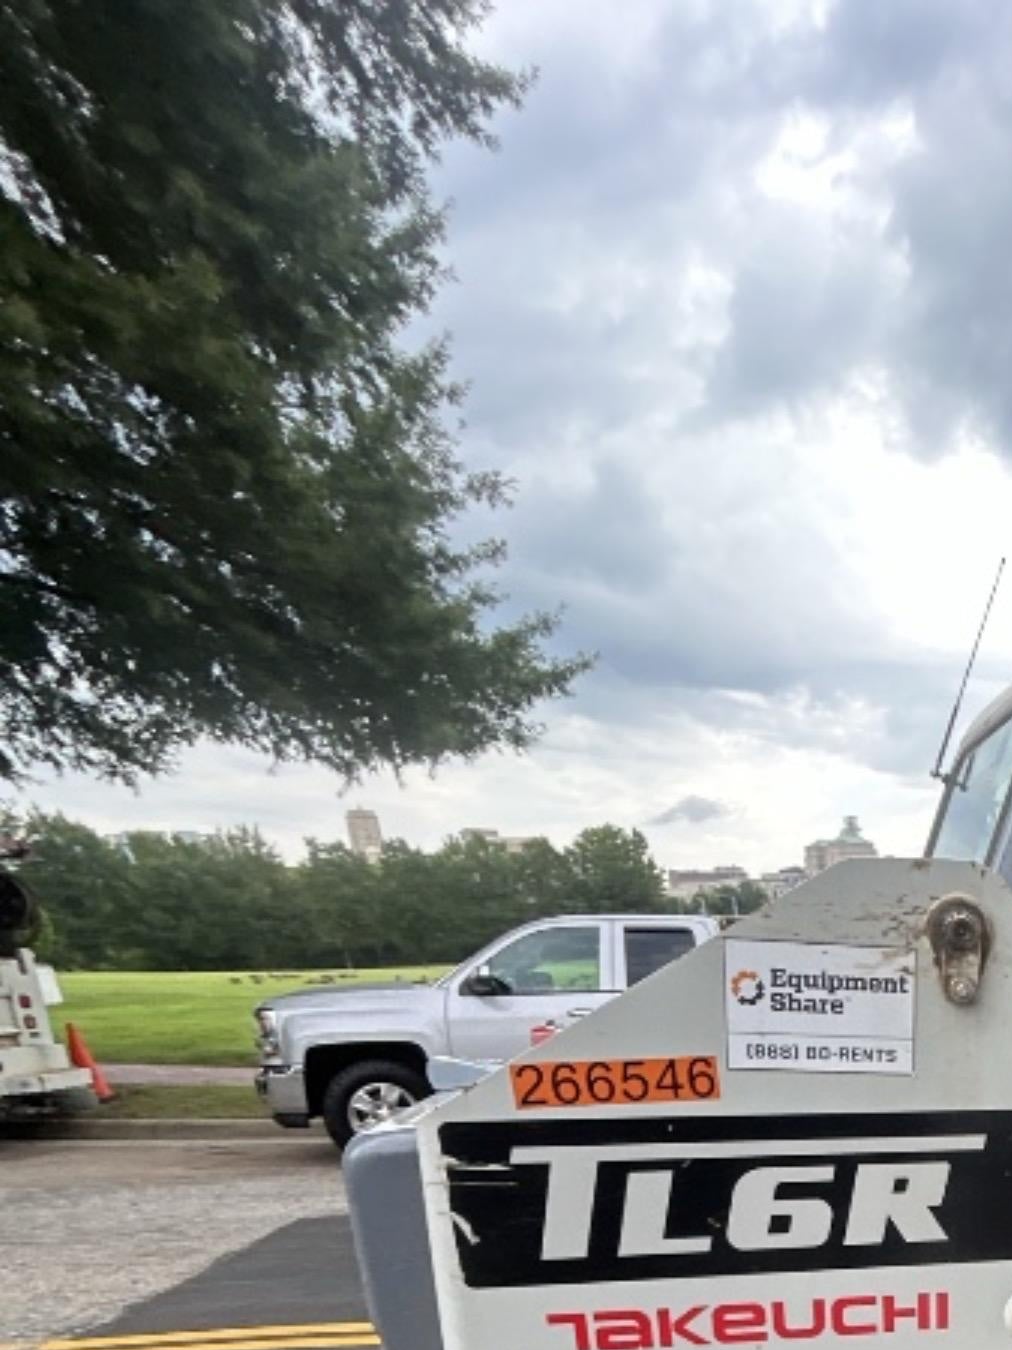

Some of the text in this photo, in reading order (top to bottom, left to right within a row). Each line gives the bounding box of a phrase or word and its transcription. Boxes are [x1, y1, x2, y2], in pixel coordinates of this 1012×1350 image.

[769, 968, 910, 994] Equipment
[769, 992, 845, 1015] Share
[514, 1057, 718, 1107] 266546
[508, 1132, 988, 1262] TL6R
